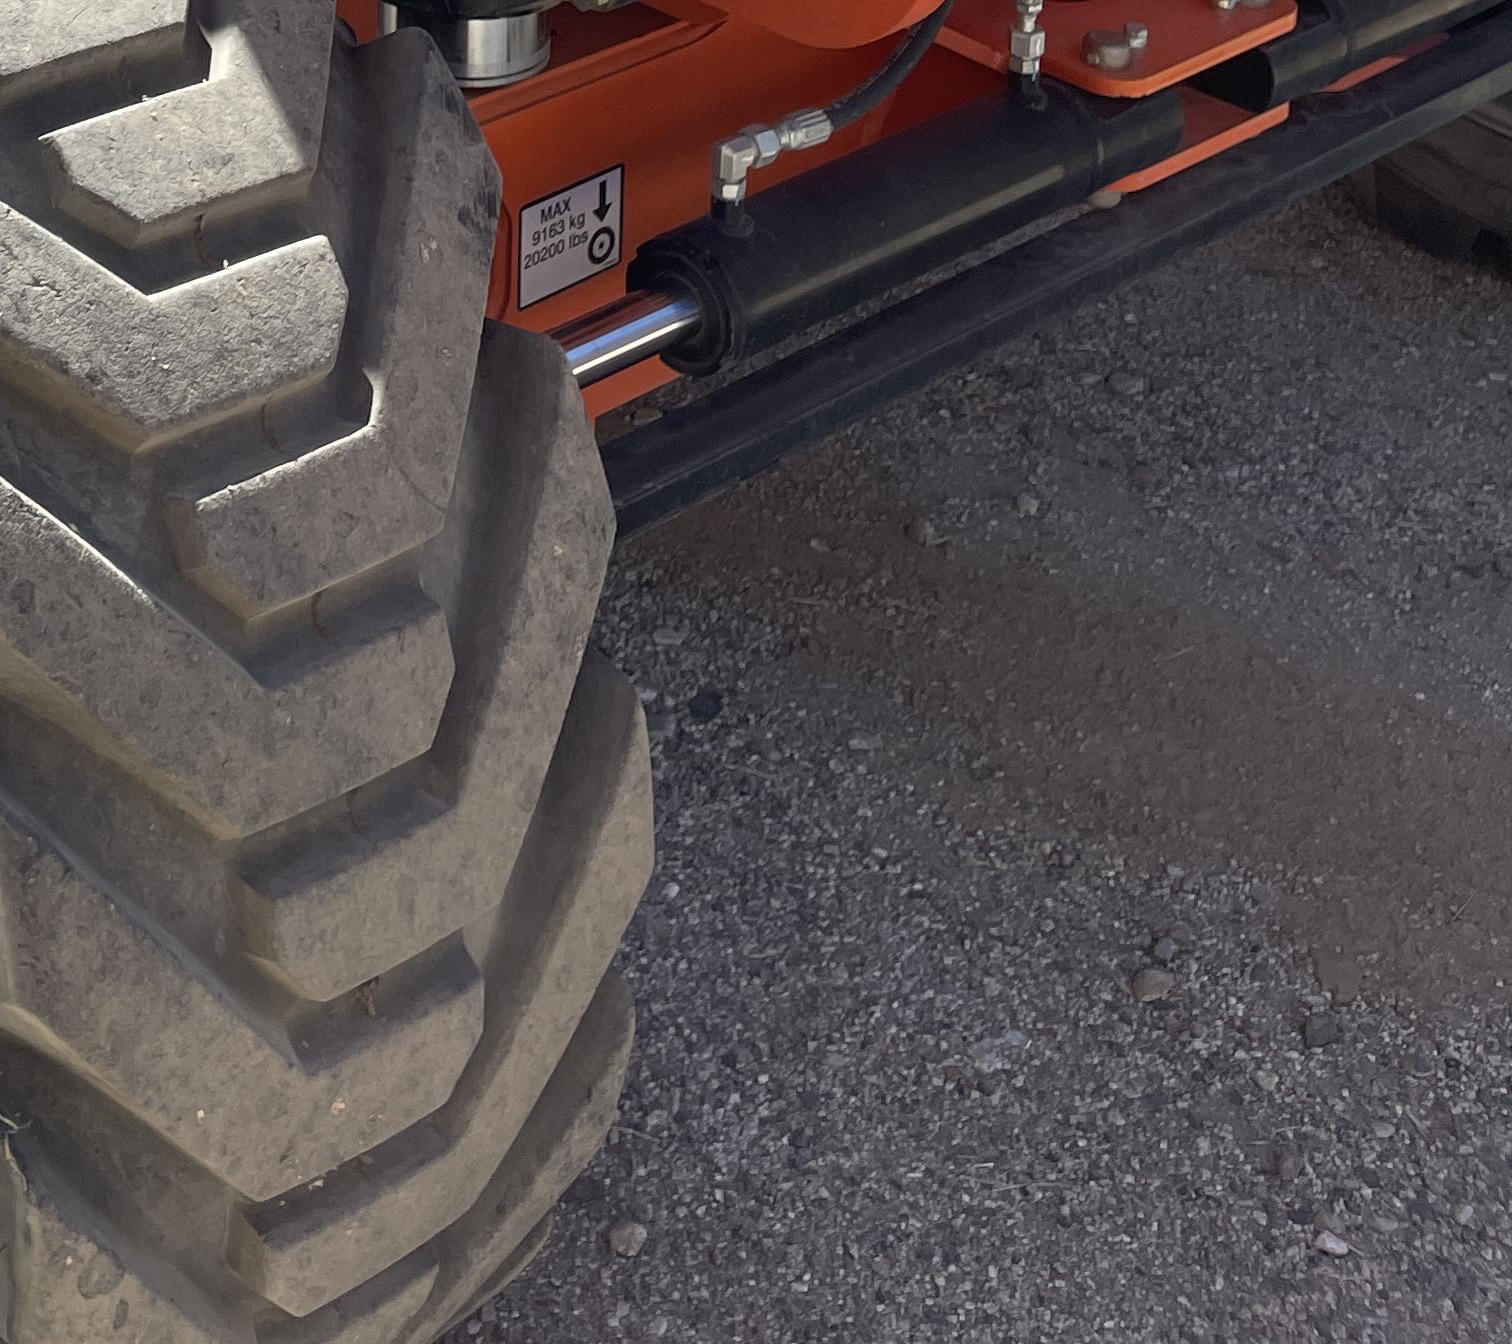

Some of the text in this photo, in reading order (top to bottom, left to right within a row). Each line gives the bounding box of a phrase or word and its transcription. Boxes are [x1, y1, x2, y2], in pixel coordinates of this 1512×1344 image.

[540, 196, 572, 224] MAX
[531, 212, 586, 246] 9163 kg
[523, 230, 589, 271] 20200 lbs
